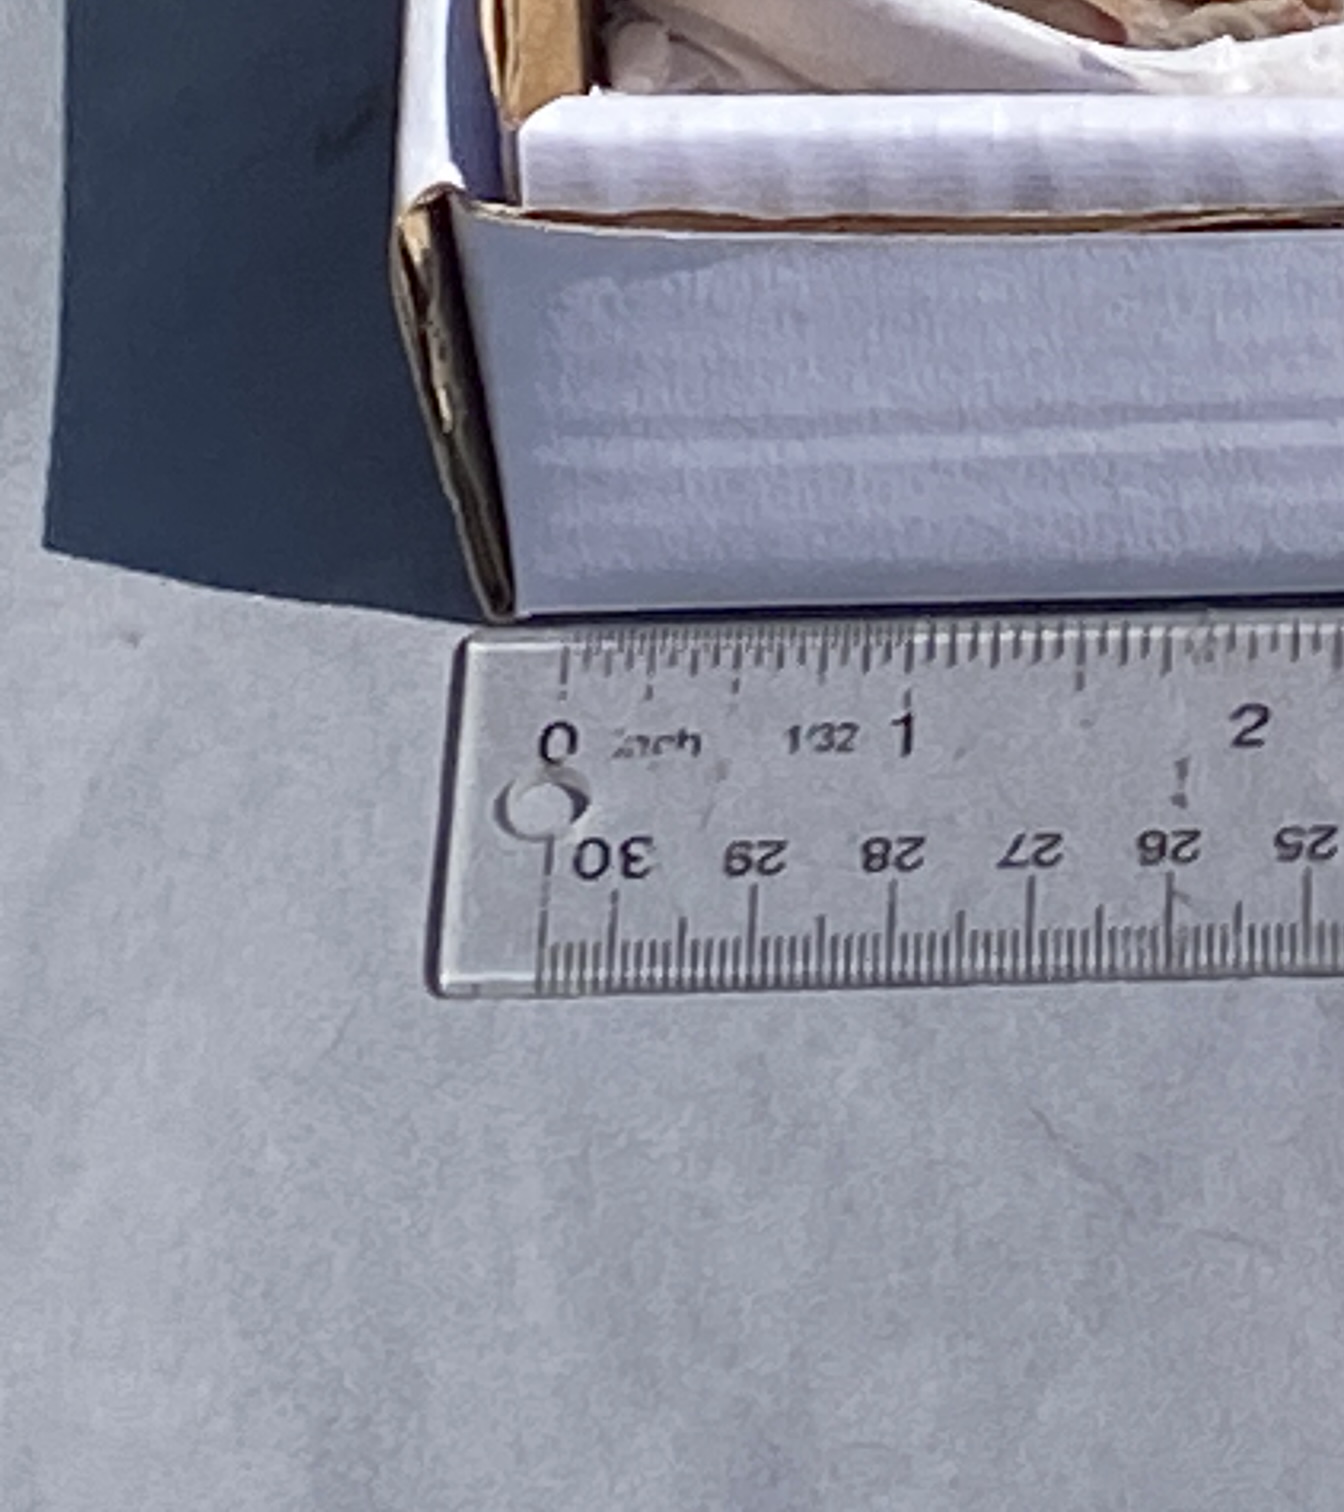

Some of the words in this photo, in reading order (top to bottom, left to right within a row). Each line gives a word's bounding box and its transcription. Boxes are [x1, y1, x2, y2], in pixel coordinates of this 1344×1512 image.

[539, 721, 579, 765] 0
[890, 711, 915, 758] 1
[1228, 702, 1272, 749] 2
[572, 835, 655, 881] 30
[722, 838, 790, 878] 29
[860, 835, 927, 874] 28
[995, 831, 1065, 869] 27
[1135, 828, 1202, 868] 26
[1272, 824, 1340, 864] 25
